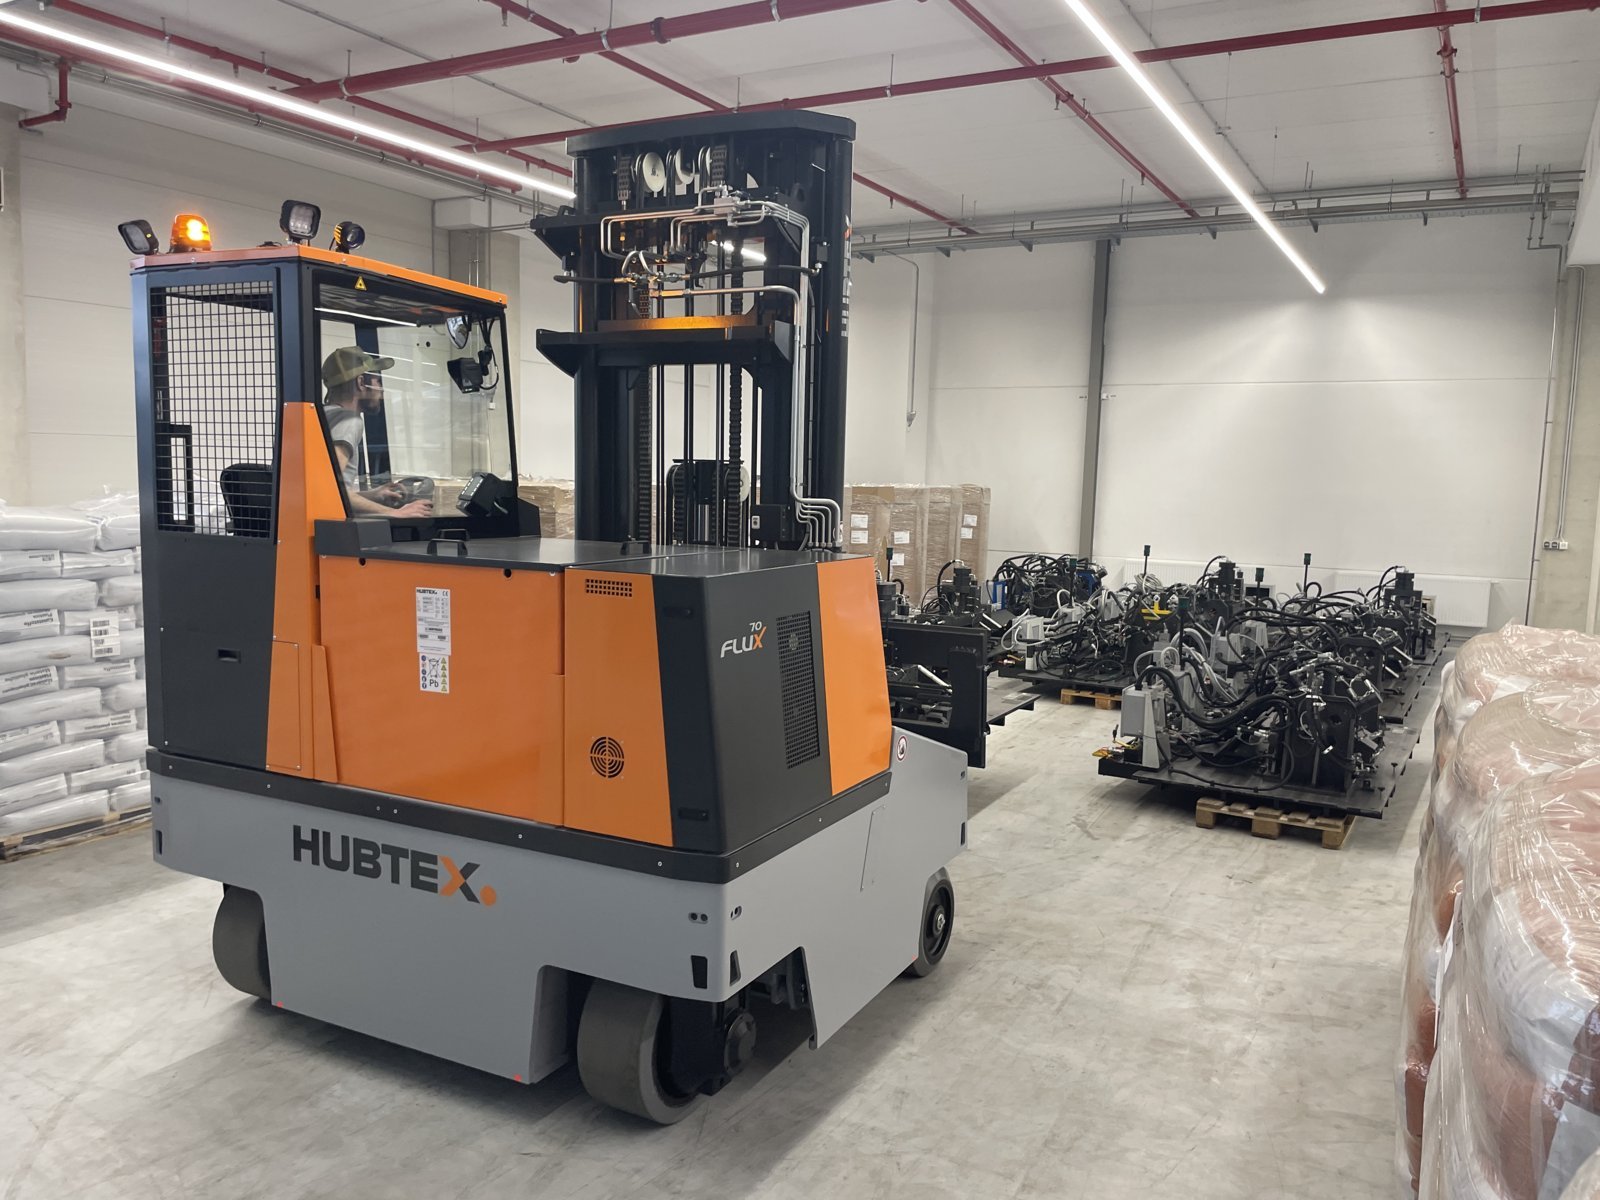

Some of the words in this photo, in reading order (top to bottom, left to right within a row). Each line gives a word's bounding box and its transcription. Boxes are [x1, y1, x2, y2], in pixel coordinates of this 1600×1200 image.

[749, 621, 762, 632] 70
[720, 626, 767, 658] FLUX
[429, 679, 439, 688] Pb
[293, 824, 481, 904] HUBTEX
